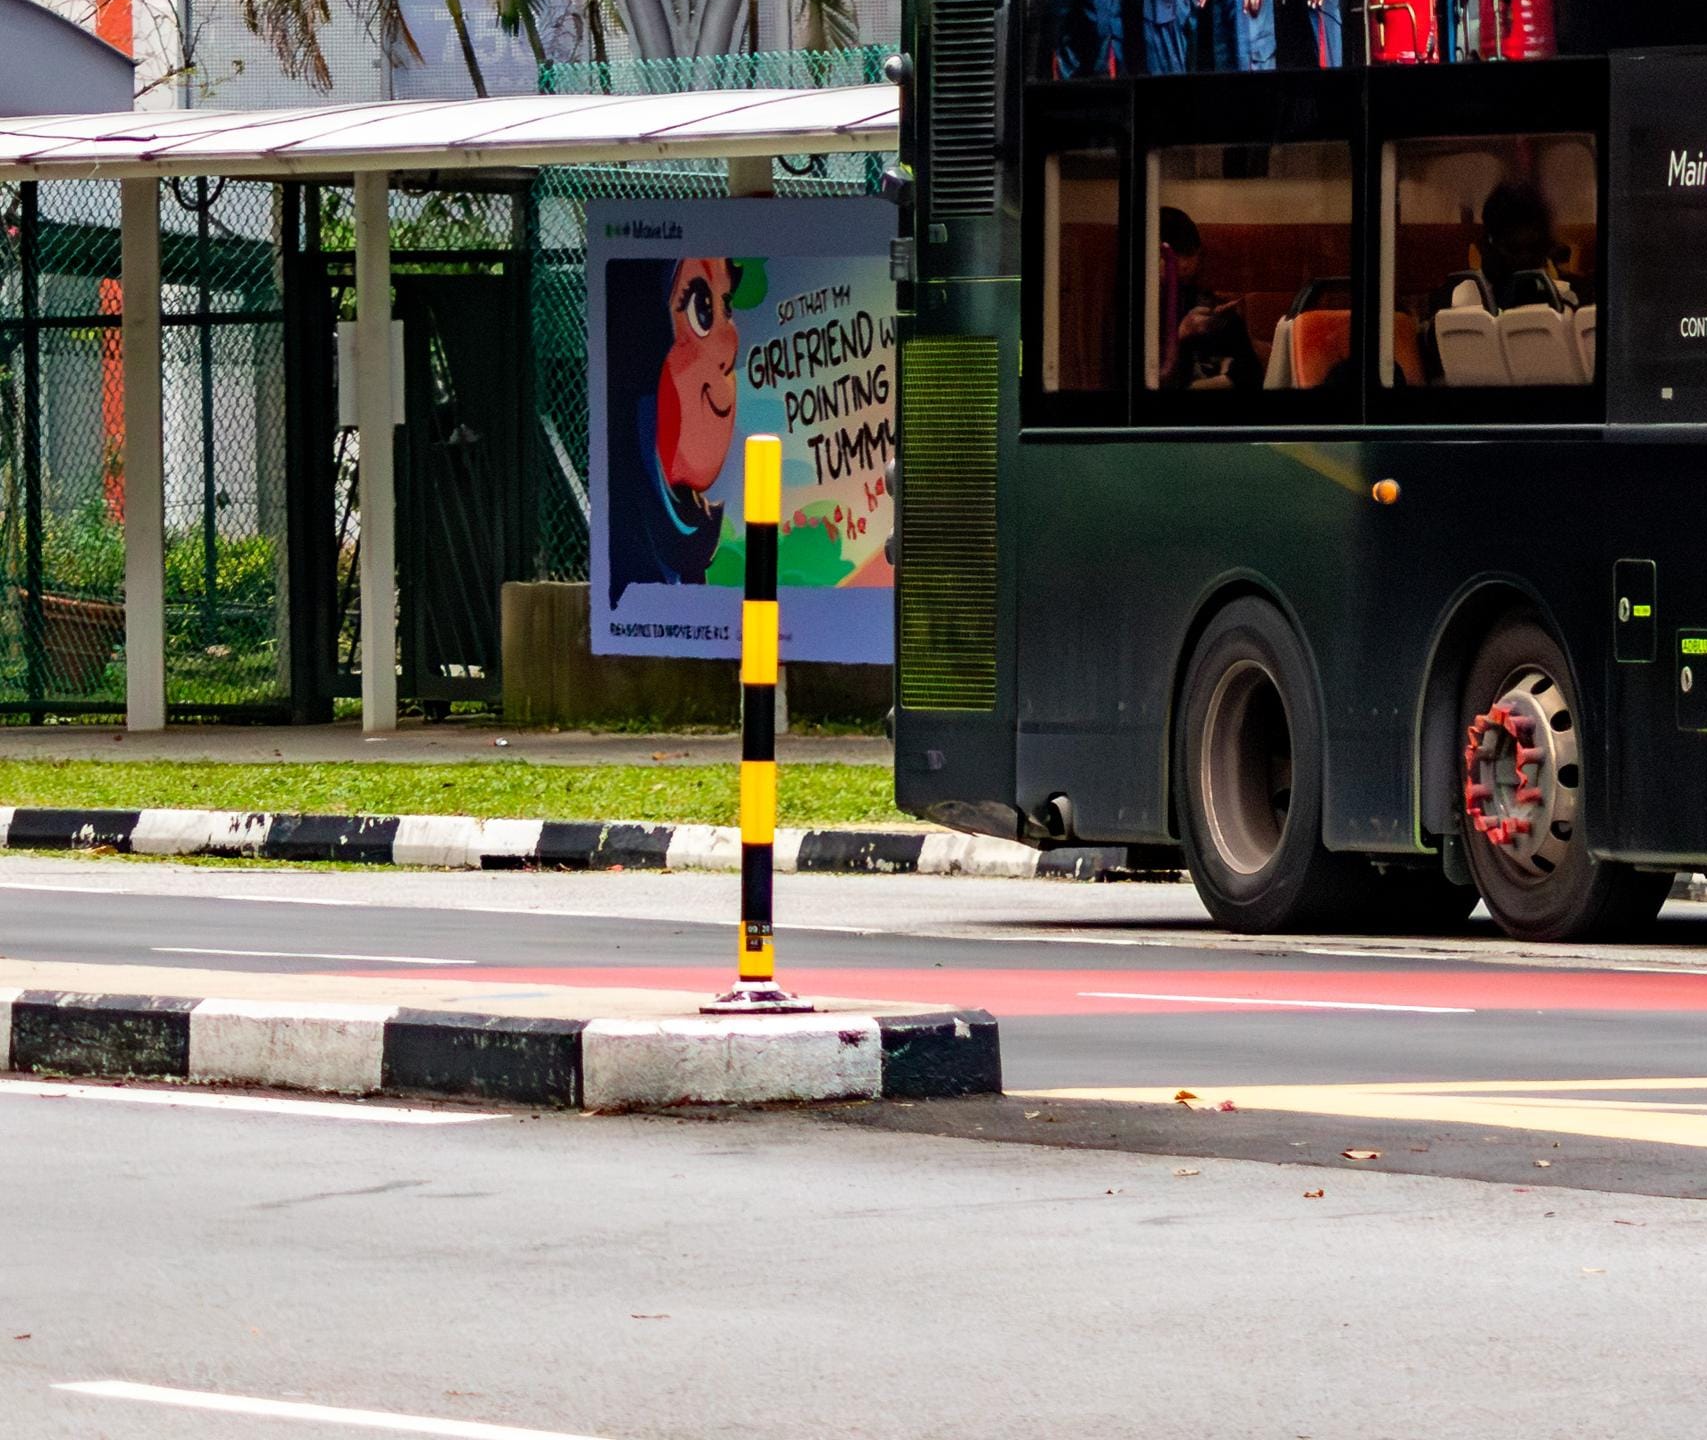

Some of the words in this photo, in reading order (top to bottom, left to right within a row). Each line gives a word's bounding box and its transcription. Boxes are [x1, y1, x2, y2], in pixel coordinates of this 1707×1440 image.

[778, 300, 796, 325] SO
[798, 288, 828, 318] THAT
[748, 310, 874, 390] GIRLFRIEND
[785, 364, 889, 433] POINTING
